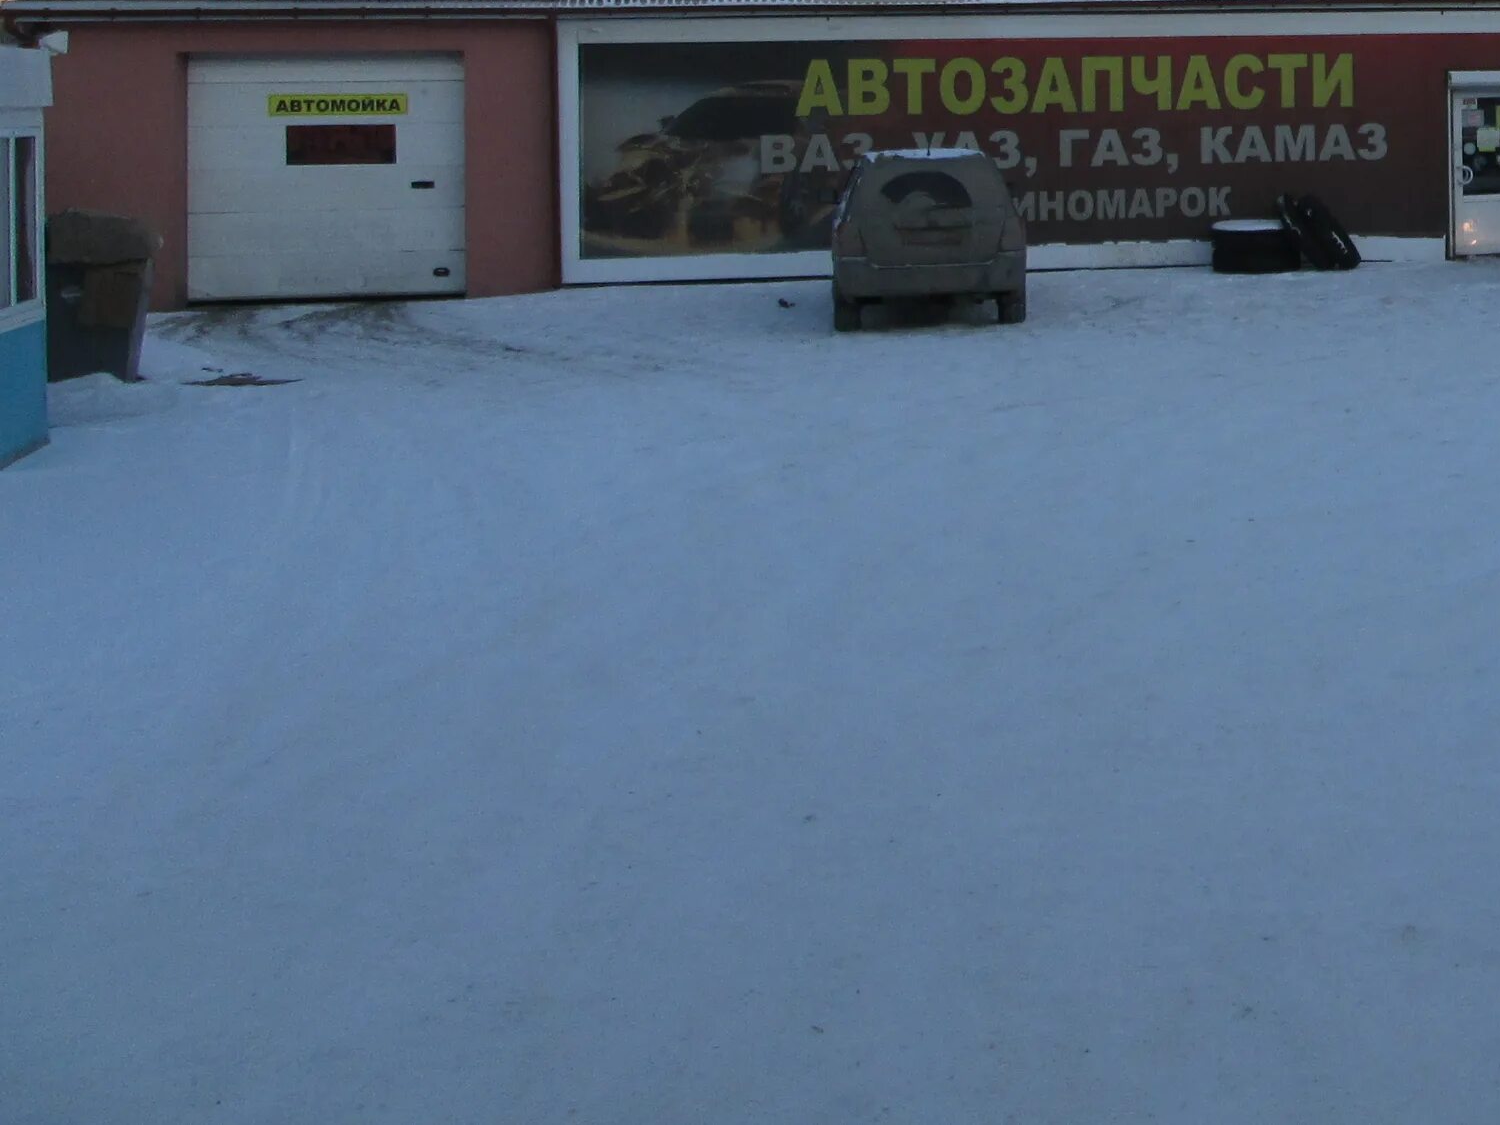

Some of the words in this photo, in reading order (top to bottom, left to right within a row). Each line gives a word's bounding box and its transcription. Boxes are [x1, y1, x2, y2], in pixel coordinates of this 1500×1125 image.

[276, 97, 400, 113] АВТОМОЙКА
[795, 52, 1355, 117] АВТОЗАПЧАСТИ
[1058, 125, 1179, 175] ГАЗ,
[1199, 121, 1388, 164] КАМАЗ
[1012, 185, 1232, 224] ИНОМАРОК
